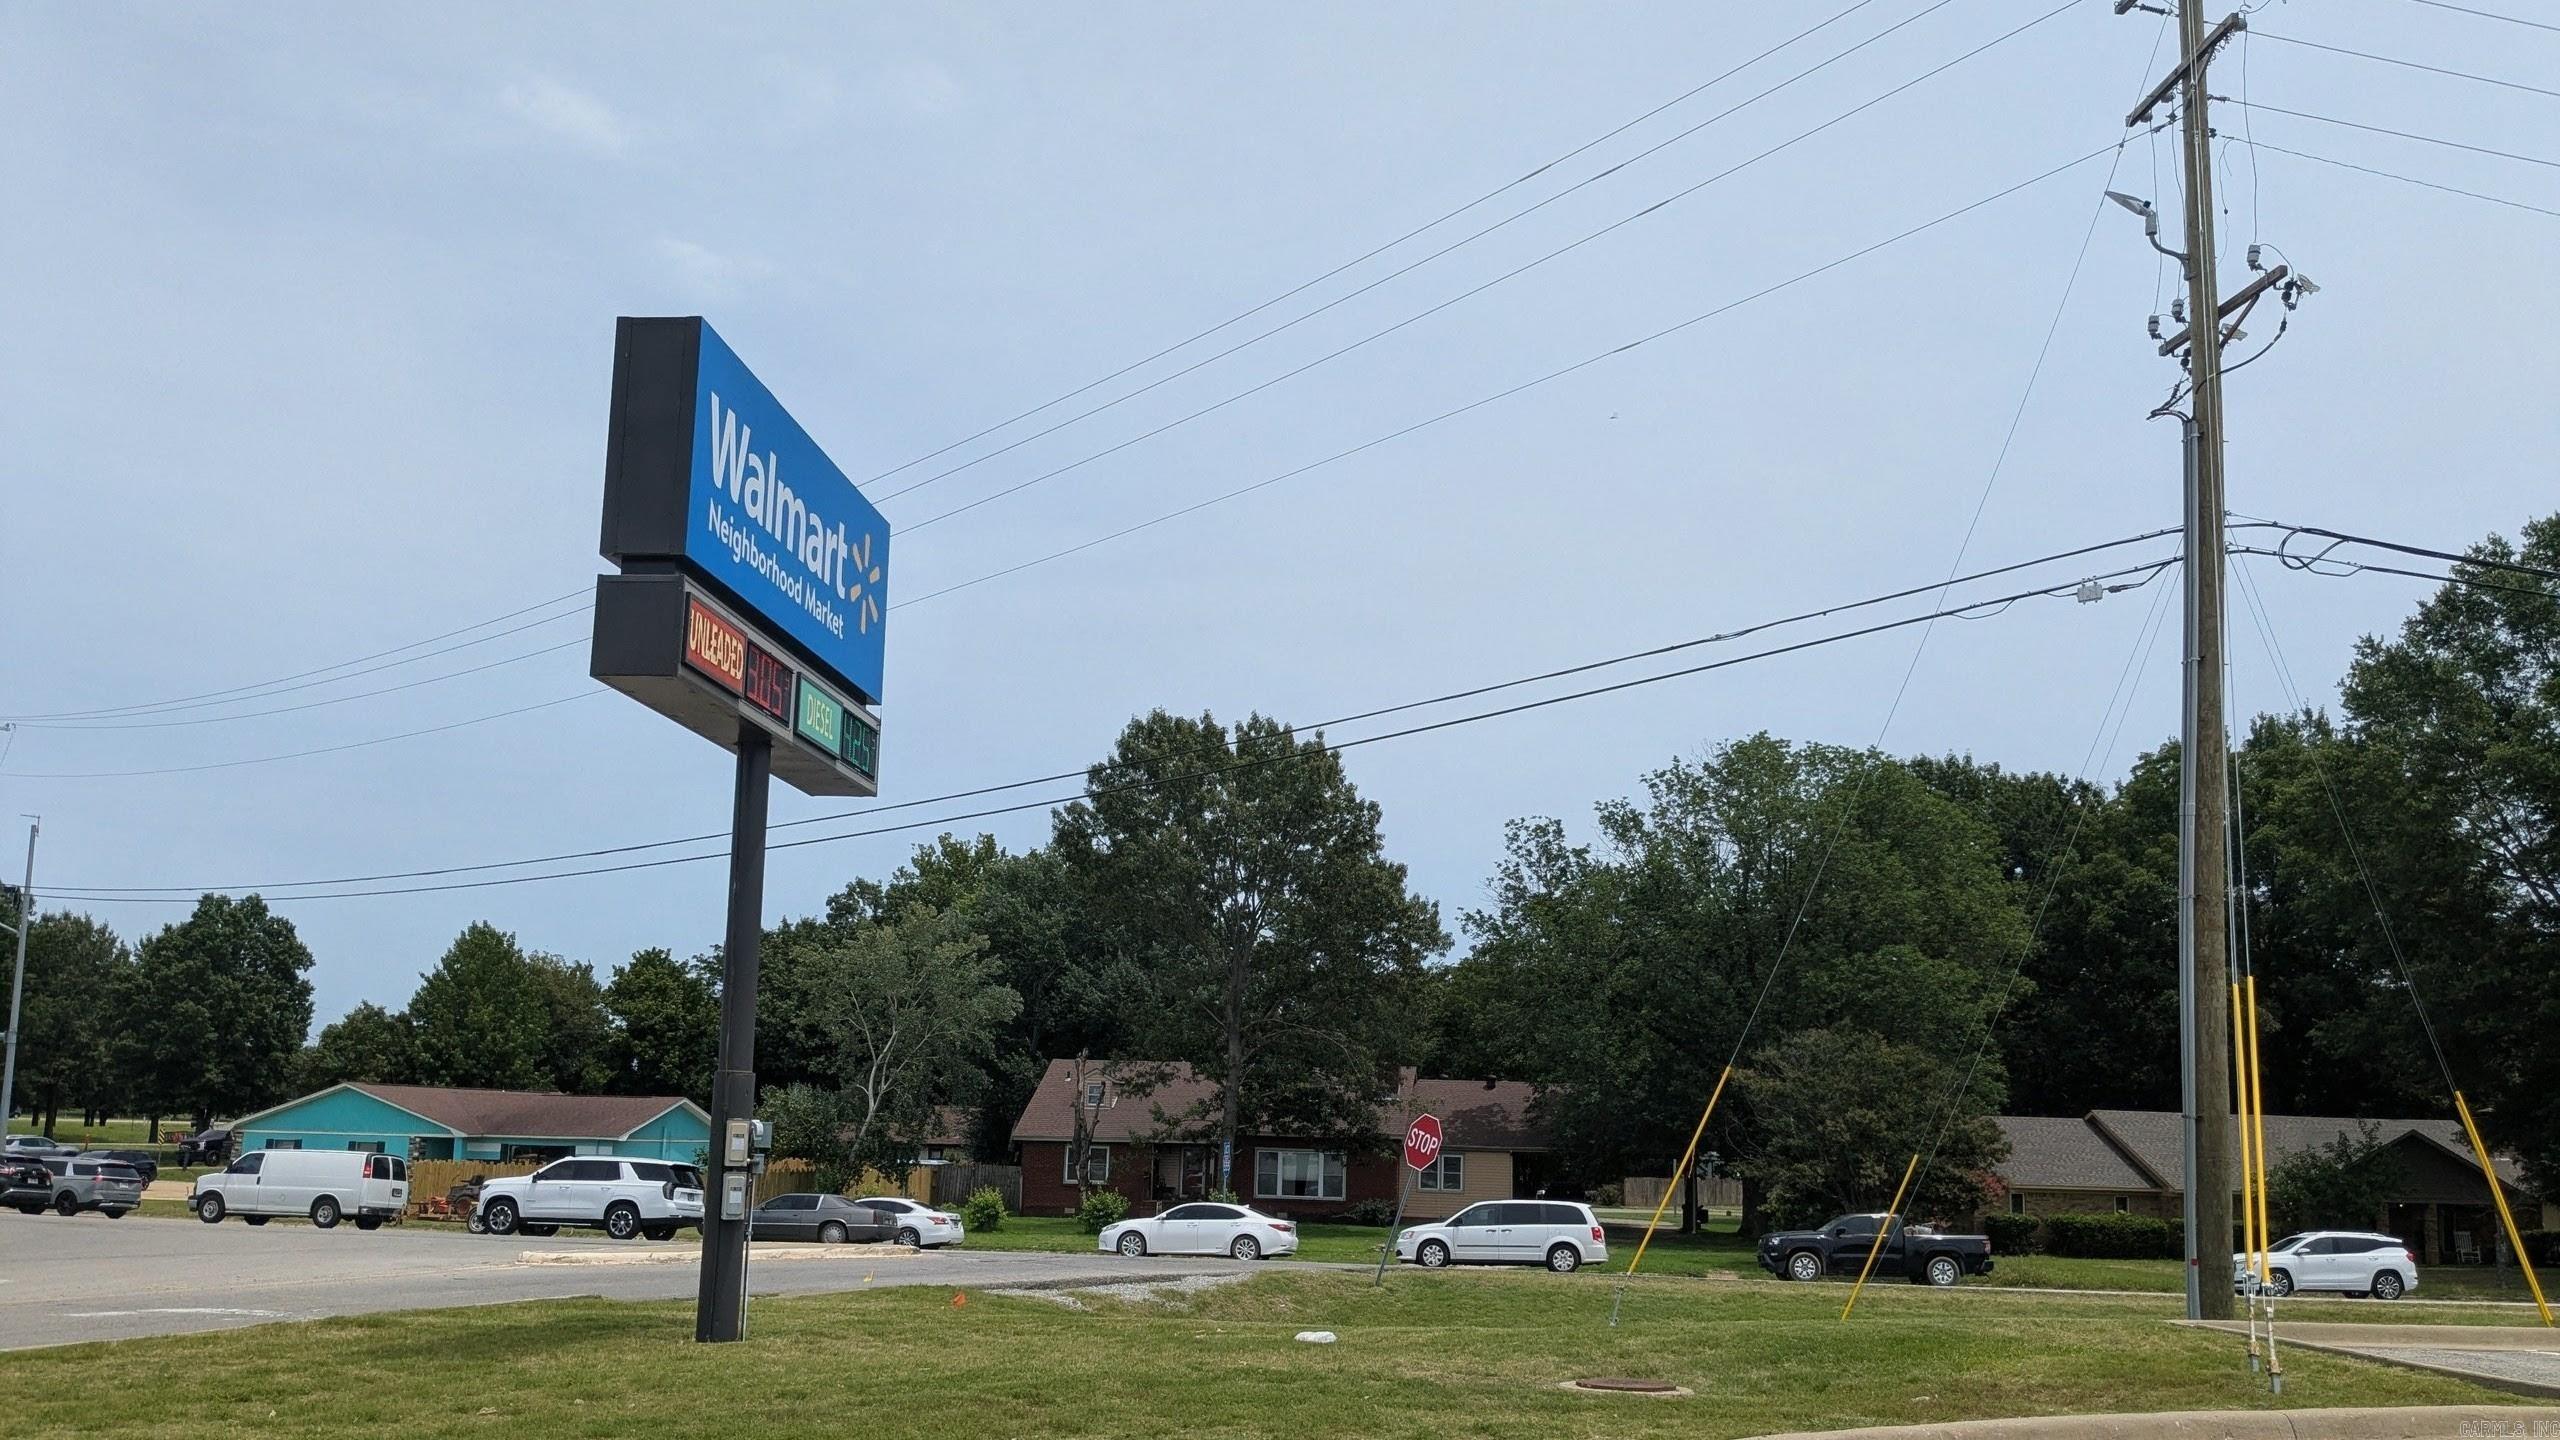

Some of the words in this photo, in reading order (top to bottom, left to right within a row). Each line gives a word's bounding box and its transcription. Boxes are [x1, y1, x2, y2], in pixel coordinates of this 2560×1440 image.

[711, 391, 848, 600] Walmart
[708, 497, 803, 605] Neighborhood
[804, 582, 843, 640] Market
[689, 609, 744, 680] UNLEADED
[806, 693, 833, 740] DIESEL
[1408, 1128, 1438, 1156] STOP
